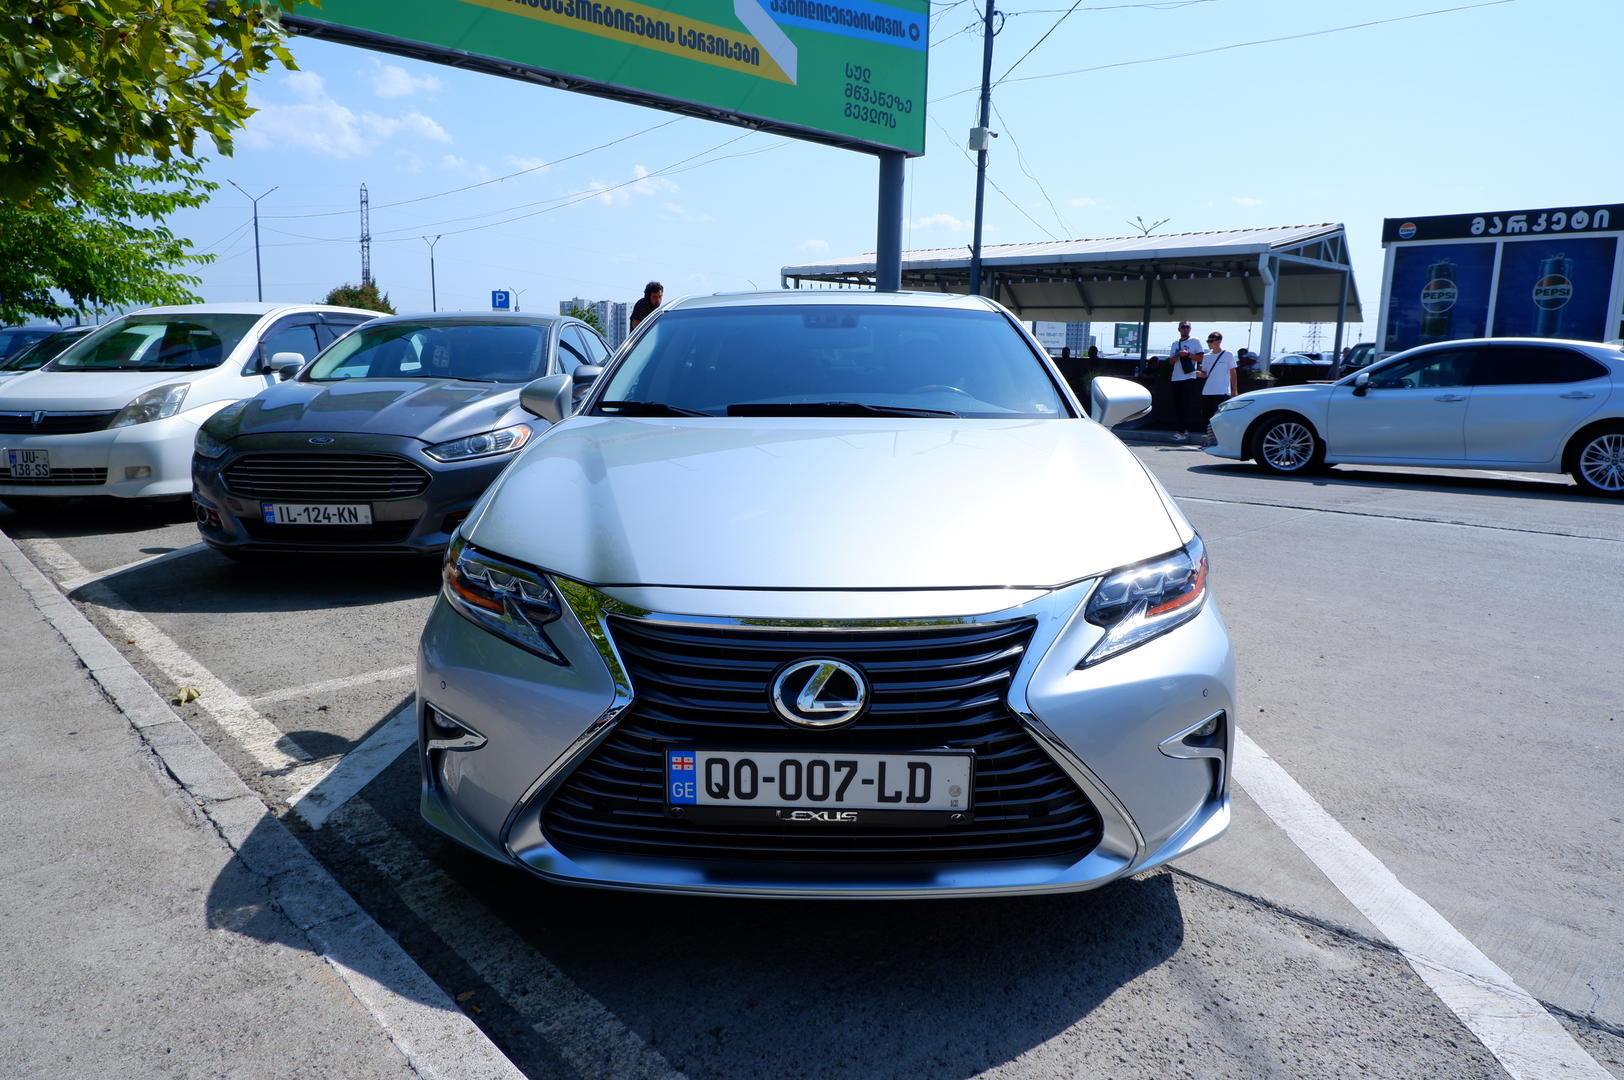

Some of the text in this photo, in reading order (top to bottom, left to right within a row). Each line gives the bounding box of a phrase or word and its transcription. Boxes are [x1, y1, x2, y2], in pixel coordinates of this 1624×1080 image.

[508, 0, 761, 67] სპორტირების სერვისები
[845, 62, 872, 84] სულ
[844, 82, 913, 114] მწვანეზე
[843, 102, 897, 129] გევლოს
[1470, 208, 1611, 236] მარკეტი
[495, 292, 506, 307] P
[1422, 290, 1456, 301] PEPSI
[1534, 287, 1571, 298] PEPSI
[11, 463, 49, 477] 138-SS
[278, 506, 360, 524] IL-124-KN
[672, 782, 695, 798] GE
